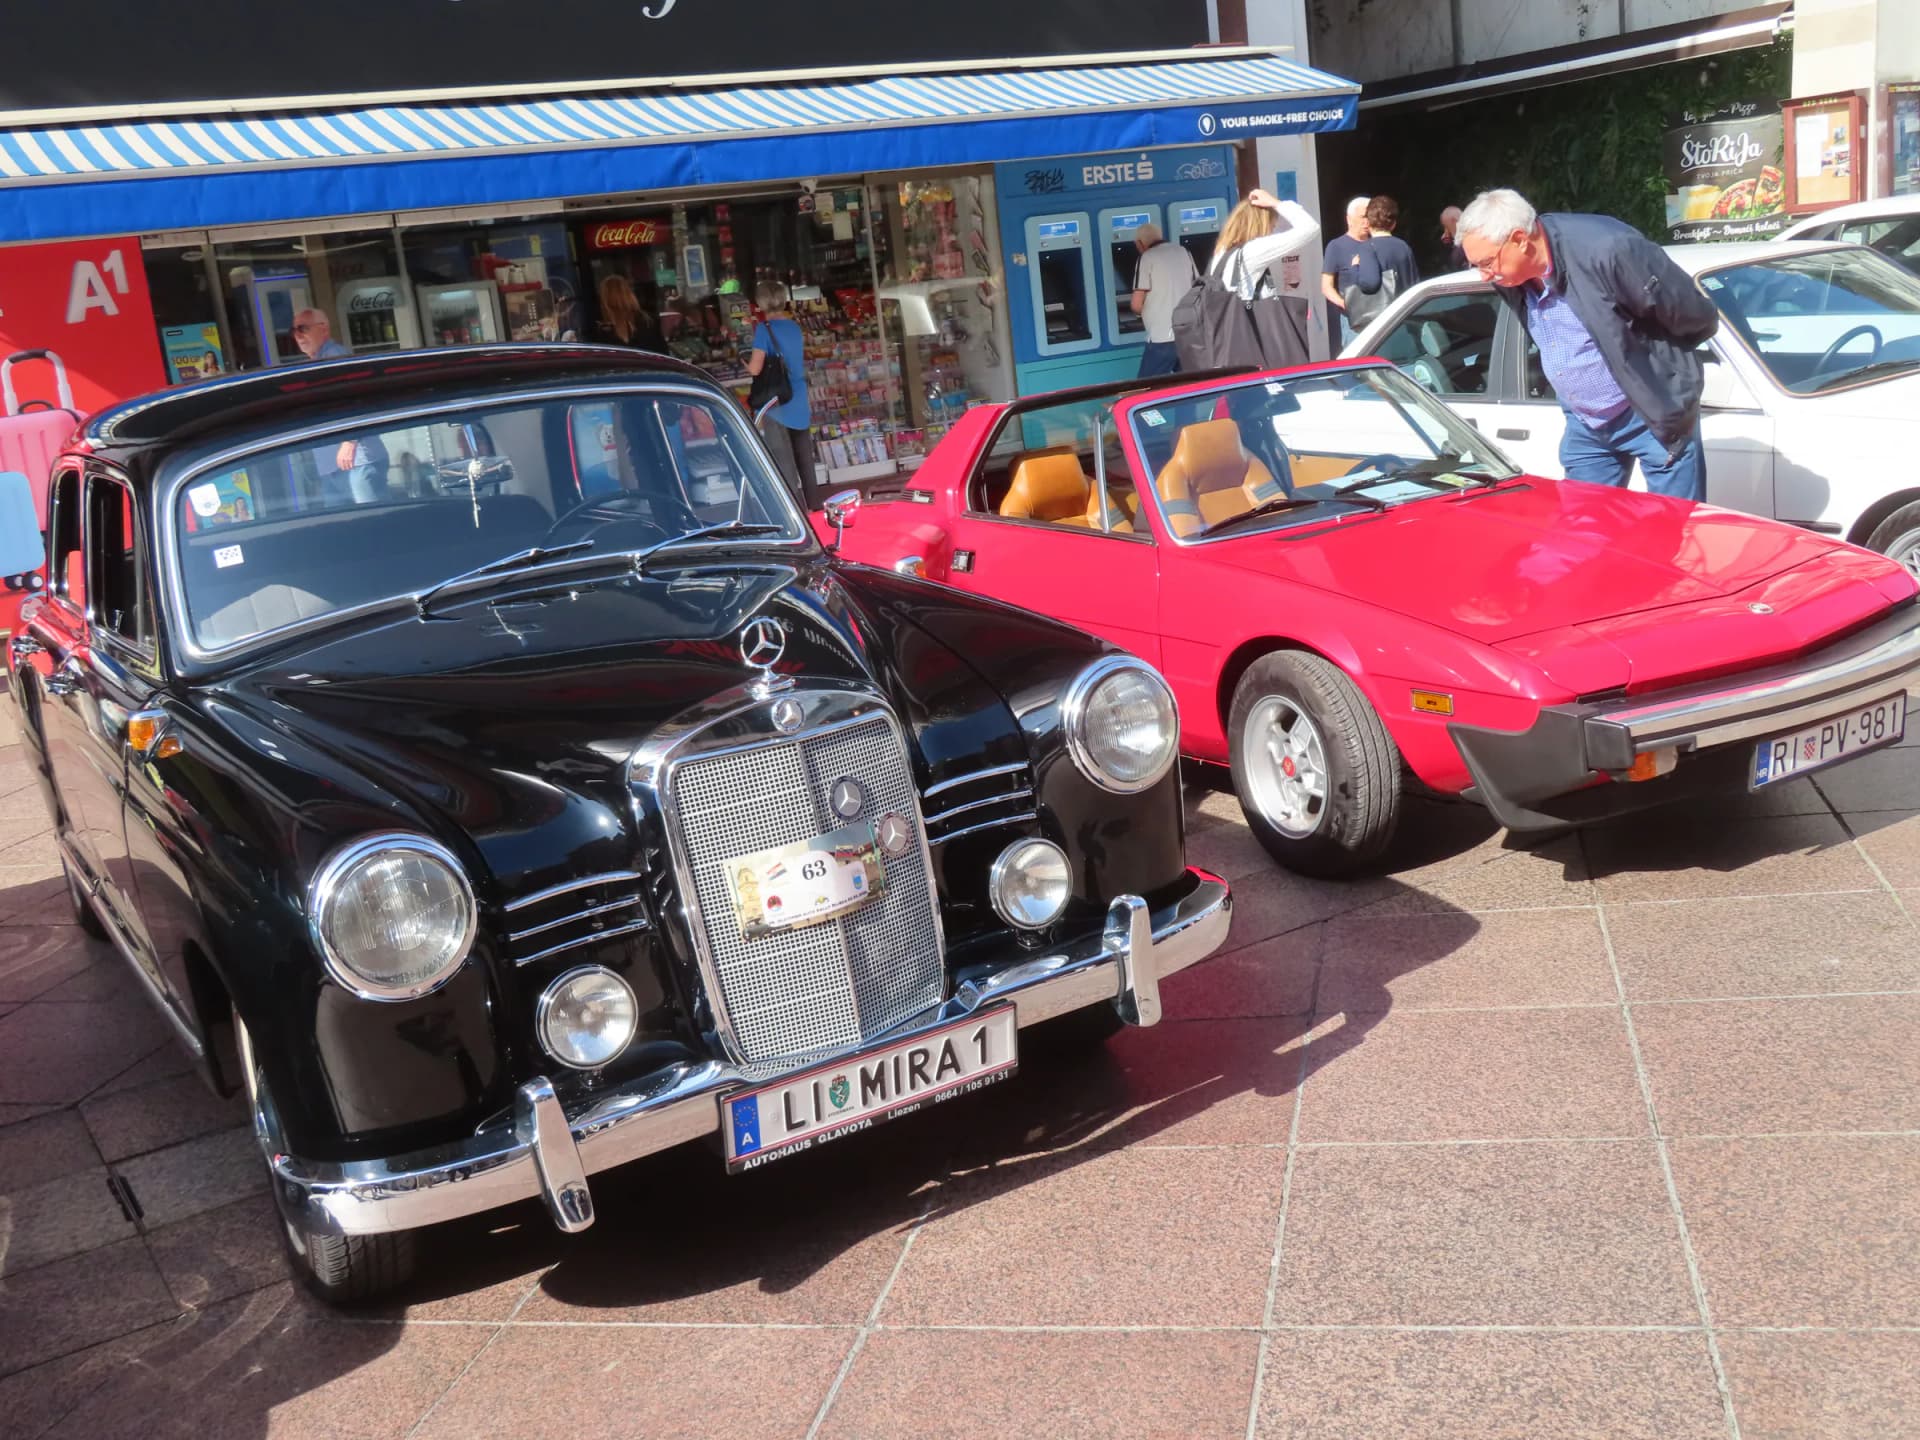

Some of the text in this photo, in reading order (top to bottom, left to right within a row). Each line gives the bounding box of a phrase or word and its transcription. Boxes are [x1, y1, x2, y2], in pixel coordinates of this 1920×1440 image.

[1220, 109, 1344, 129] YOUR SMOKE-FREE CHOICE
[1082, 162, 1136, 186] ERSTE
[65, 249, 129, 324] A1
[1772, 737, 1798, 776] RI
[1756, 767, 1768, 779] HR
[802, 859, 827, 880] 63
[783, 1025, 987, 1132] LI MIRA 1
[743, 1139, 812, 1170] AUTOHAUS
[818, 1118, 873, 1144] GLAVOTA
[887, 1103, 921, 1120] Liezen
[966, 1080, 983, 1092] 105
[983, 1075, 996, 1086] 91
[998, 1070, 1009, 1081] 31
[742, 1132, 754, 1146] A
